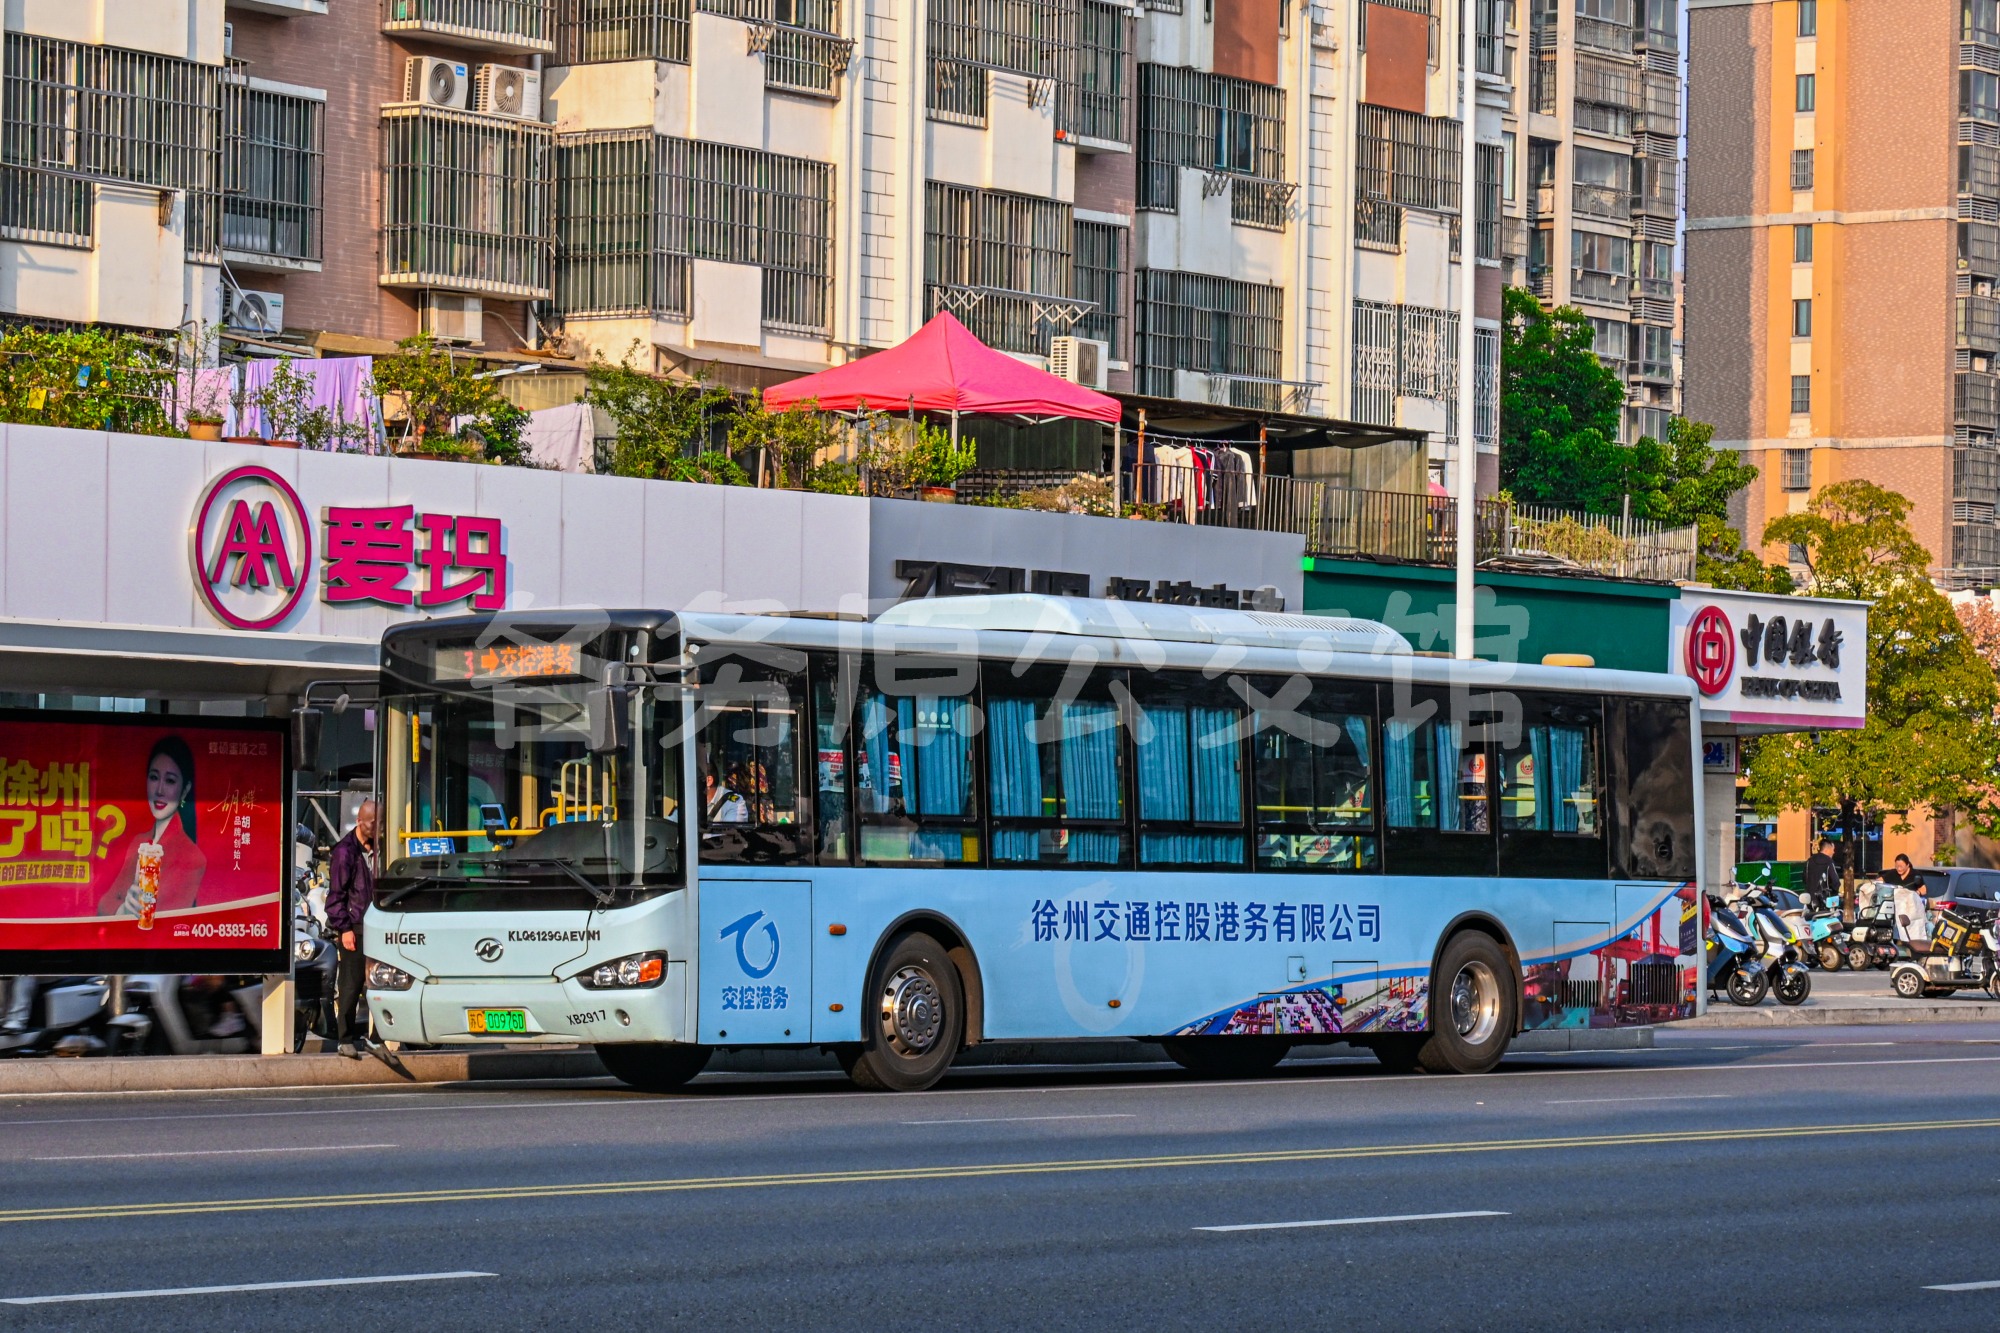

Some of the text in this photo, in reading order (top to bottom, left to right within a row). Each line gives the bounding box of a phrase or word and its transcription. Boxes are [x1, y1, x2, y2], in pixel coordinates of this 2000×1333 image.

[320, 504, 507, 610] 爱玛
[1740, 613, 1844, 669] 中国银行
[500, 644, 575, 677] 交控港务
[0, 757, 90, 808] 徐州
[233, 816, 241, 871] 品牌创始人
[411, 842, 449, 856] 上车二元
[191, 923, 268, 938] 400-8383-166
[508, 929, 601, 943] KLQ6129GAEVN1
[1032, 899, 1382, 943] 徐州交通控股港务有限公司
[385, 932, 426, 946] HIGER
[722, 984, 789, 1011] 交控港务
[566, 1010, 607, 1026] XB2917
